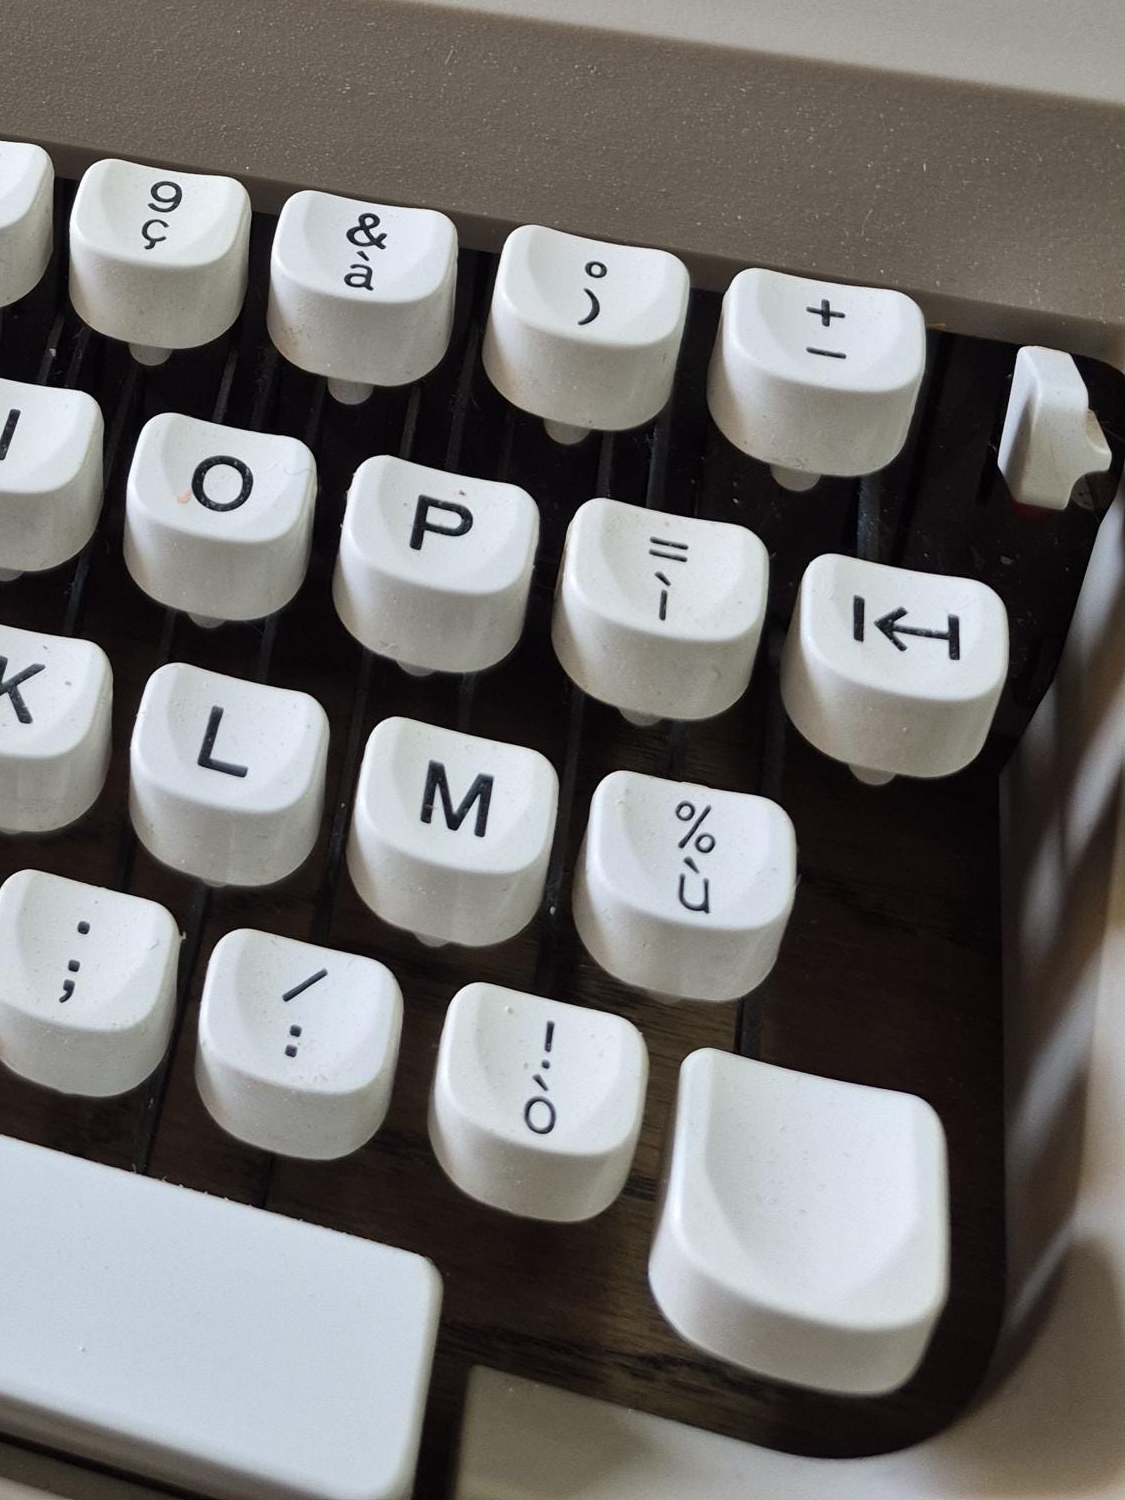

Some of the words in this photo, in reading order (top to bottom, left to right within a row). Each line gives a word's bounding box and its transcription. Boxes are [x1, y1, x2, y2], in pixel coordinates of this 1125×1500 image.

[147, 180, 183, 213] 9
[141, 218, 170, 250] ç
[345, 212, 388, 250] &
[343, 250, 374, 292] à
[806, 299, 846, 328] +
[190, 455, 254, 513] O
[409, 494, 474, 551] P
[196, 705, 248, 779] L
[419, 760, 494, 838] M
[675, 801, 716, 854] %
[678, 856, 710, 915] ù
[541, 1021, 555, 1070] !
